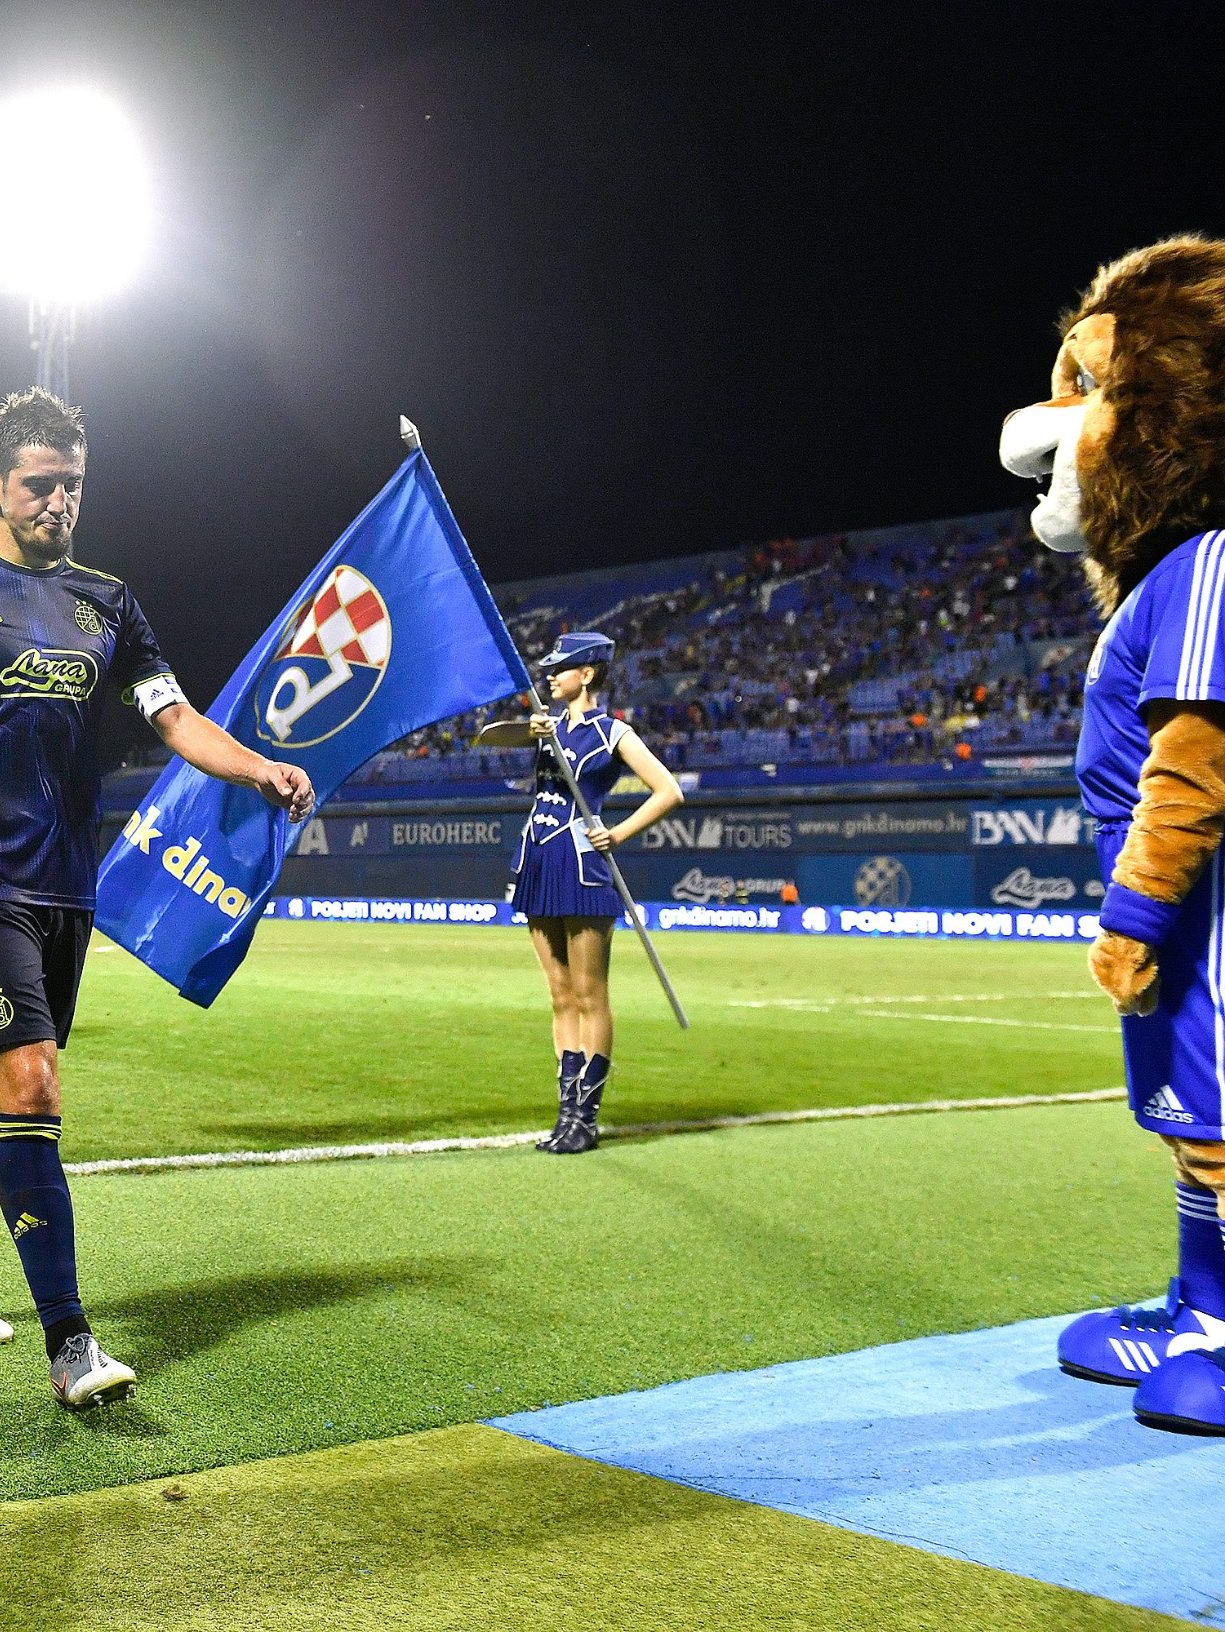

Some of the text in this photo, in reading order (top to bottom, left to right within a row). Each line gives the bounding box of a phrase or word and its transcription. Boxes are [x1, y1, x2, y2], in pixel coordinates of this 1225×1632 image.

[54, 683, 87, 696] GRUPA
[392, 821, 502, 846] EUROHERC
[726, 823, 793, 848] TOURS
[162, 836, 252, 919] dina
[311, 900, 369, 919] POSJETI
[369, 901, 412, 920] NOVI
[413, 902, 447, 921] FAN
[448, 902, 497, 923] SHOP
[658, 905, 781, 929] gnkdinamo.hr
[839, 910, 939, 934] POSJETI
[941, 912, 1013, 936] NOVI
[1016, 913, 1075, 938] FAN
[1142, 1105, 1194, 1124] adidas
